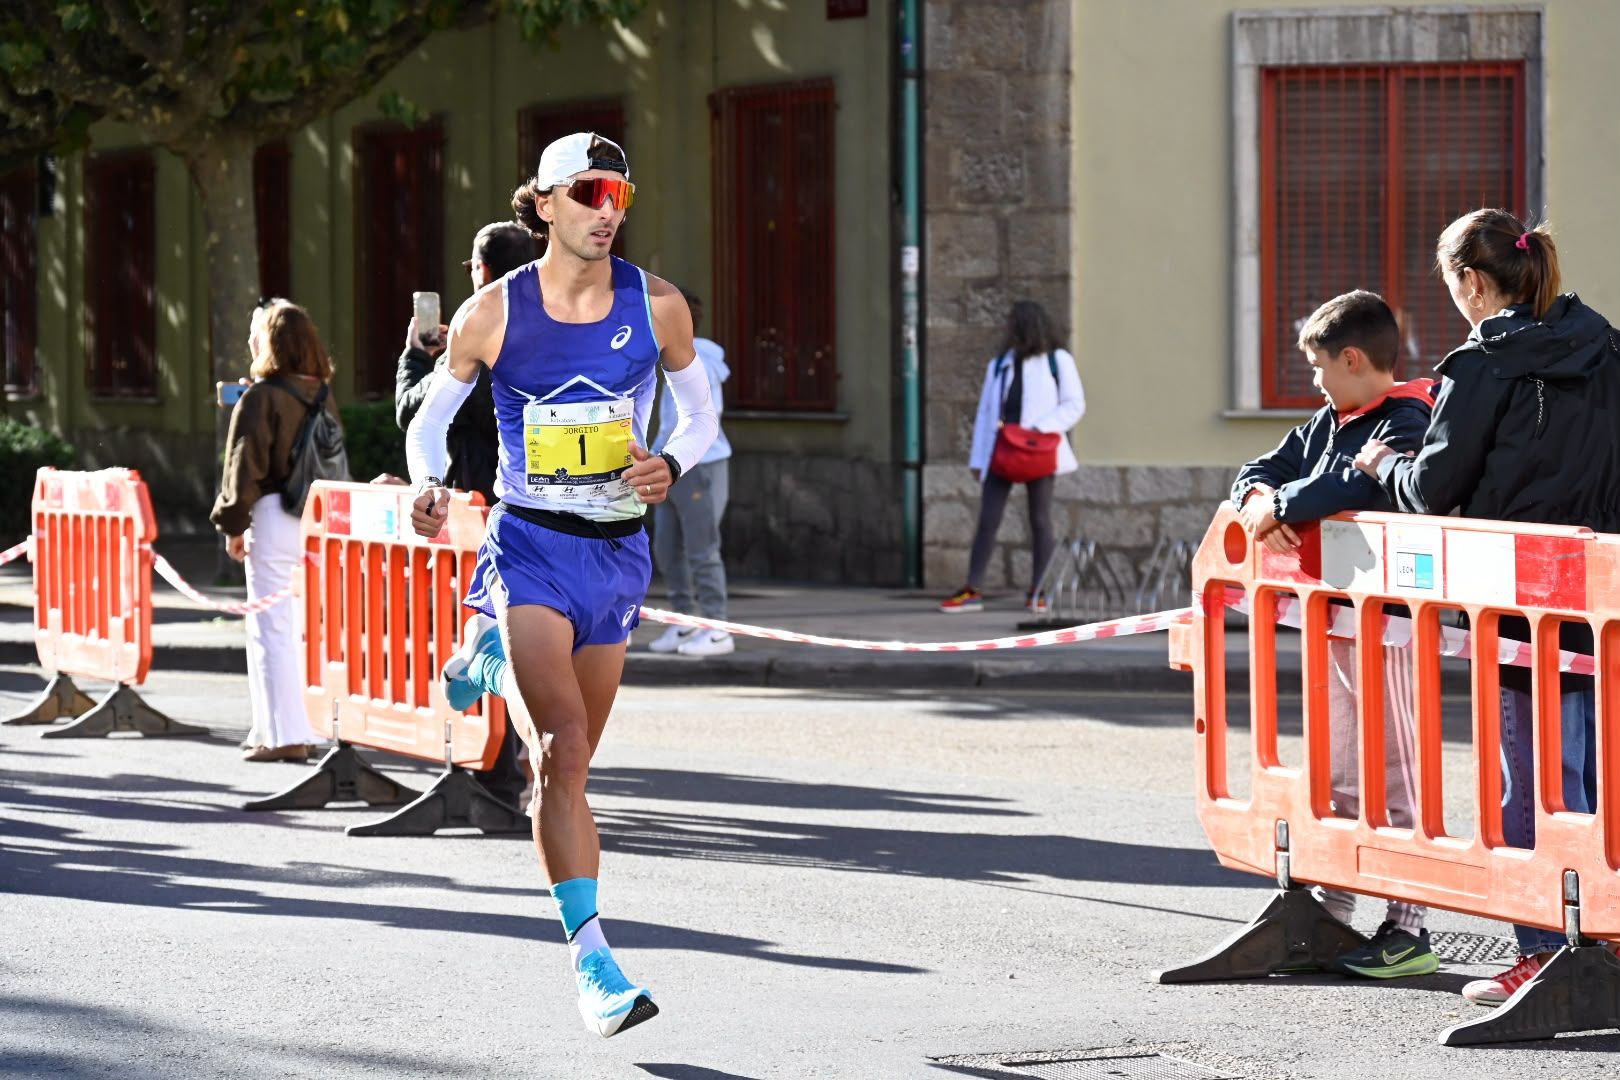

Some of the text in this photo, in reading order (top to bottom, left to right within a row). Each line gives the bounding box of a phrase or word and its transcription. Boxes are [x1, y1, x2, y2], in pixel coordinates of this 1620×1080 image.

[550, 409, 557, 417] k
[563, 425, 599, 435] JORGITO
[578, 434, 586, 466] 1
